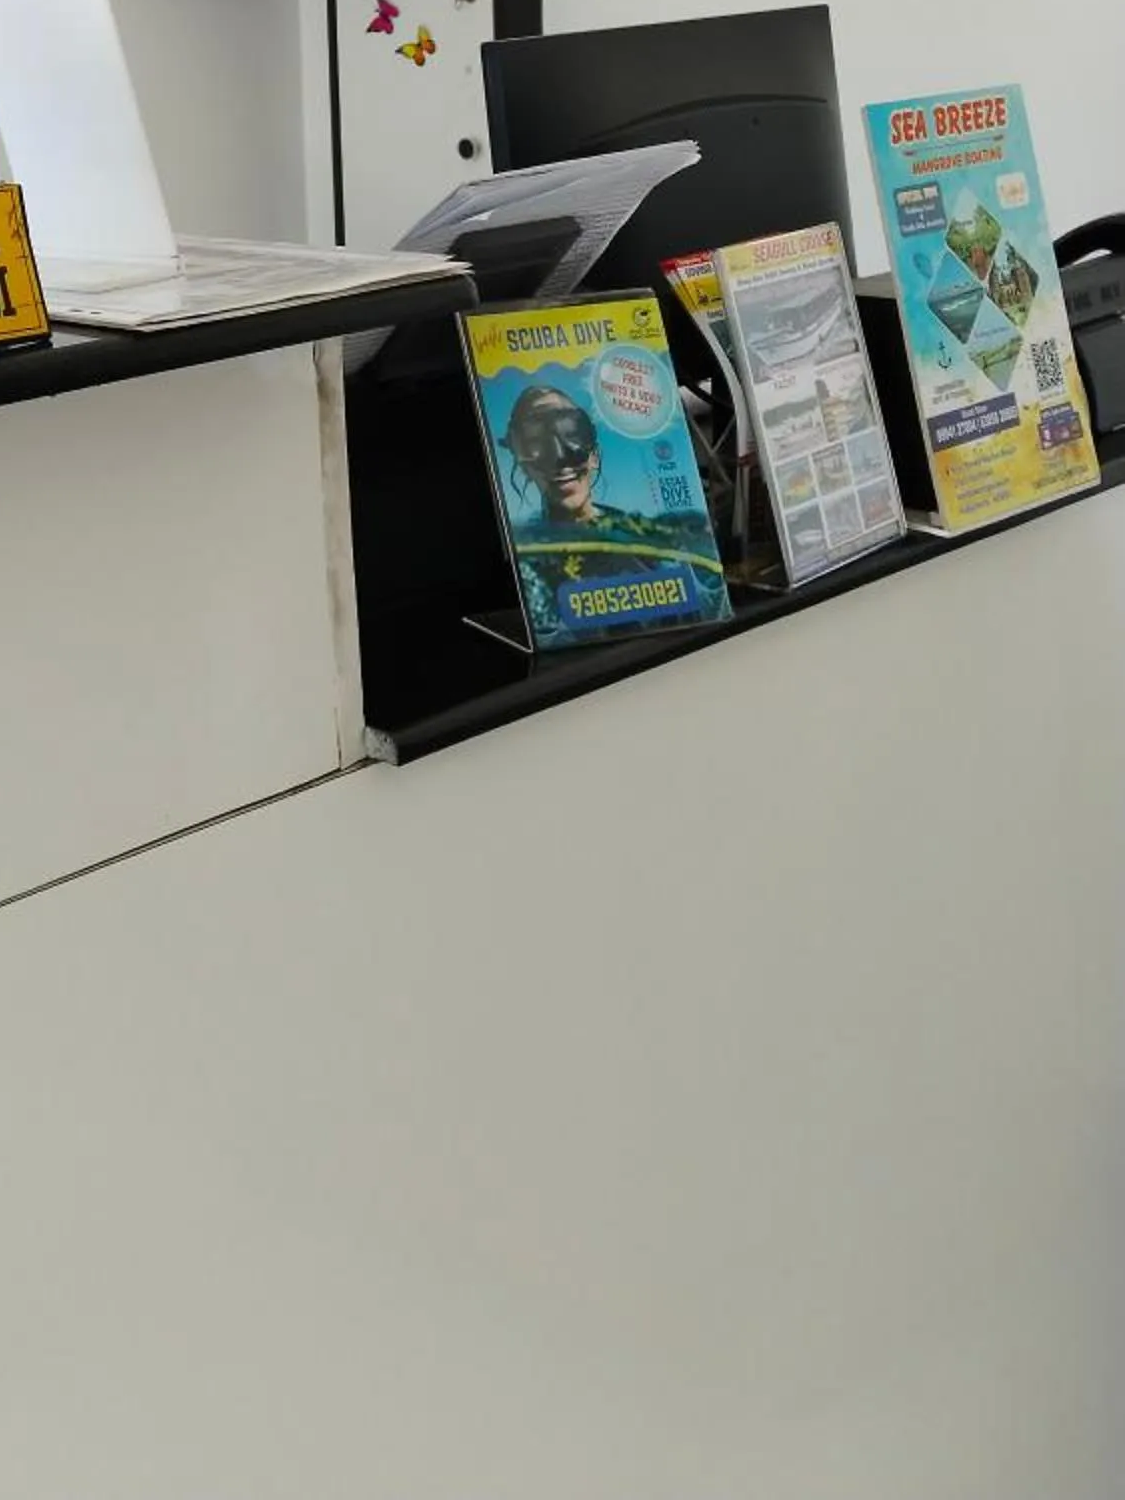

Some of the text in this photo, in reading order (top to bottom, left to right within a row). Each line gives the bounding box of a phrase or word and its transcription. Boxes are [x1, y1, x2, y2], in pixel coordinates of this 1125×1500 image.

[890, 97, 1007, 145] SEA BREEZE
[506, 323, 570, 353] SCUBA
[573, 319, 618, 346] DIVE
[569, 577, 688, 619] 9385230821
